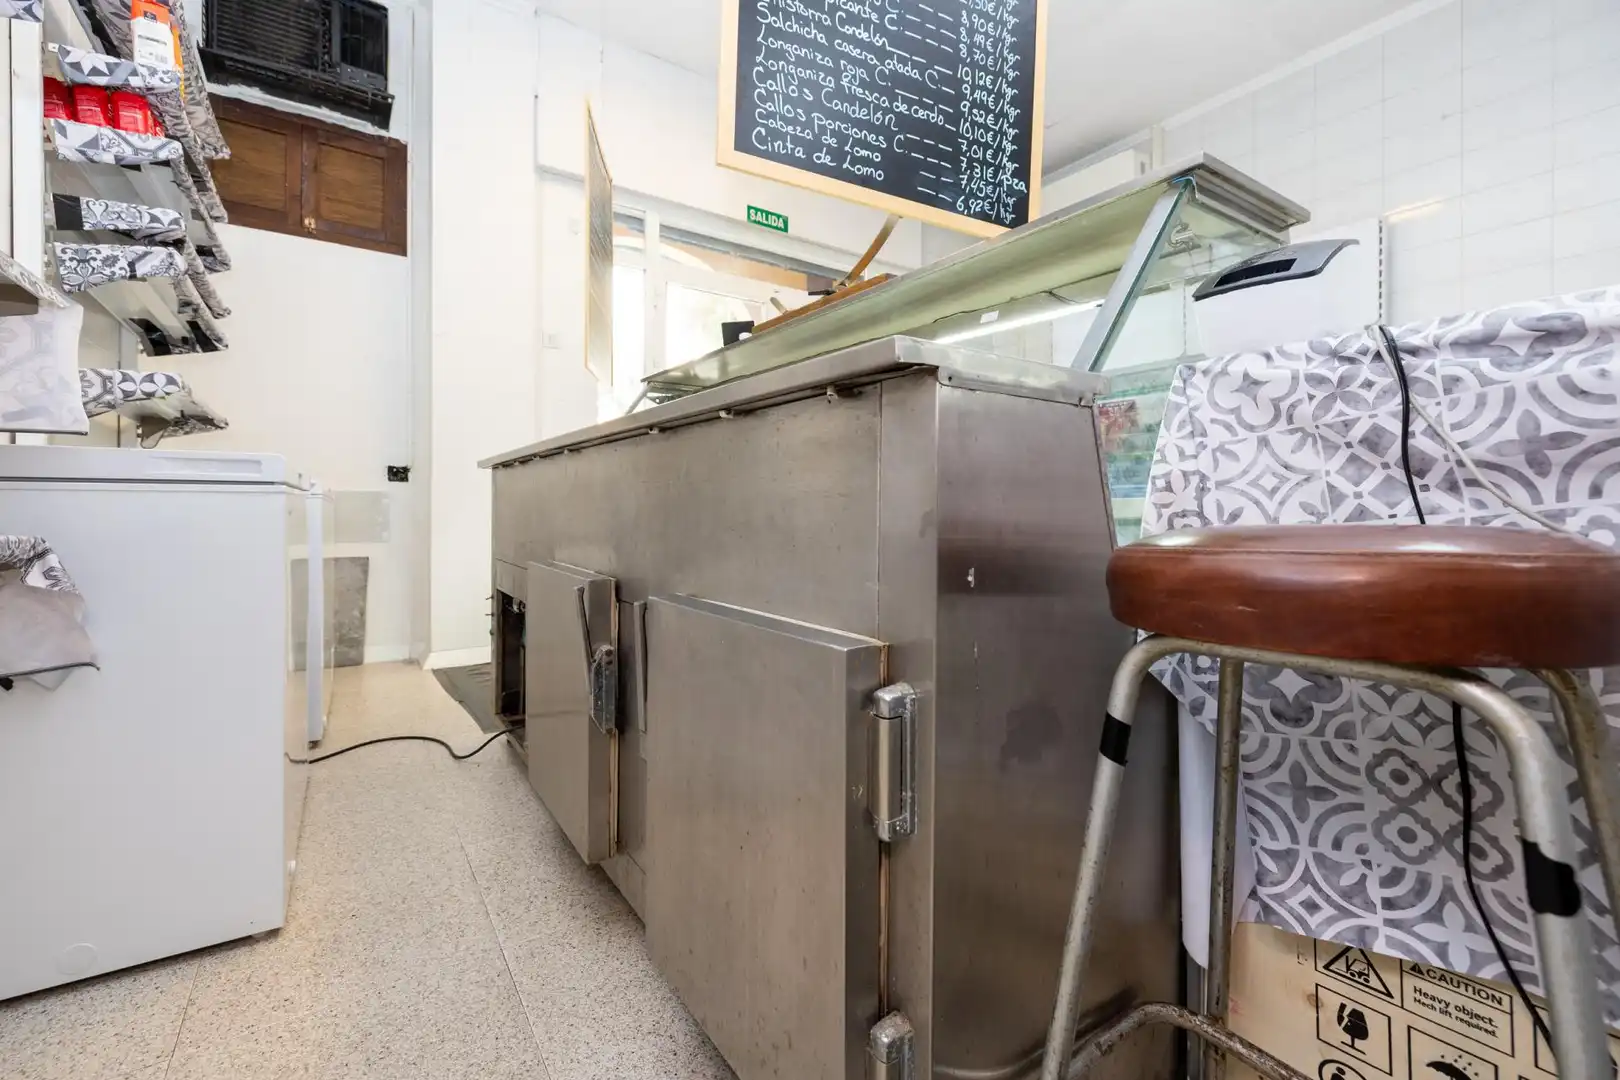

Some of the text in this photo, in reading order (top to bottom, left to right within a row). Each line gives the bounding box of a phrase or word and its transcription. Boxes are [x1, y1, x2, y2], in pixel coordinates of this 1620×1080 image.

[763, 0, 832, 27] istorra
[756, 1, 828, 46] Salchicha
[834, 39, 880, 66] casera
[885, 54, 922, 81] atada
[756, 23, 834, 68] Longaniza
[840, 60, 870, 86] roja
[755, 45, 835, 89] Longaniza
[752, 66, 813, 101] Callos
[821, 87, 899, 131] Candelón
[754, 88, 807, 121] Callos
[752, 126, 807, 159] Cinta
[812, 147, 838, 167] de
[842, 154, 885, 181] Lomo
[754, 108, 814, 141] Cabeza
[821, 129, 838, 148] de
[844, 136, 882, 162] Lomo
[749, 209, 785, 229] SALIDA
[1413, 985, 1500, 1029] Heavy object.
[1413, 996, 1437, 1012] Mech
[1439, 1006, 1453, 1019] lift
[1426, 968, 1503, 1007] CAUTION
